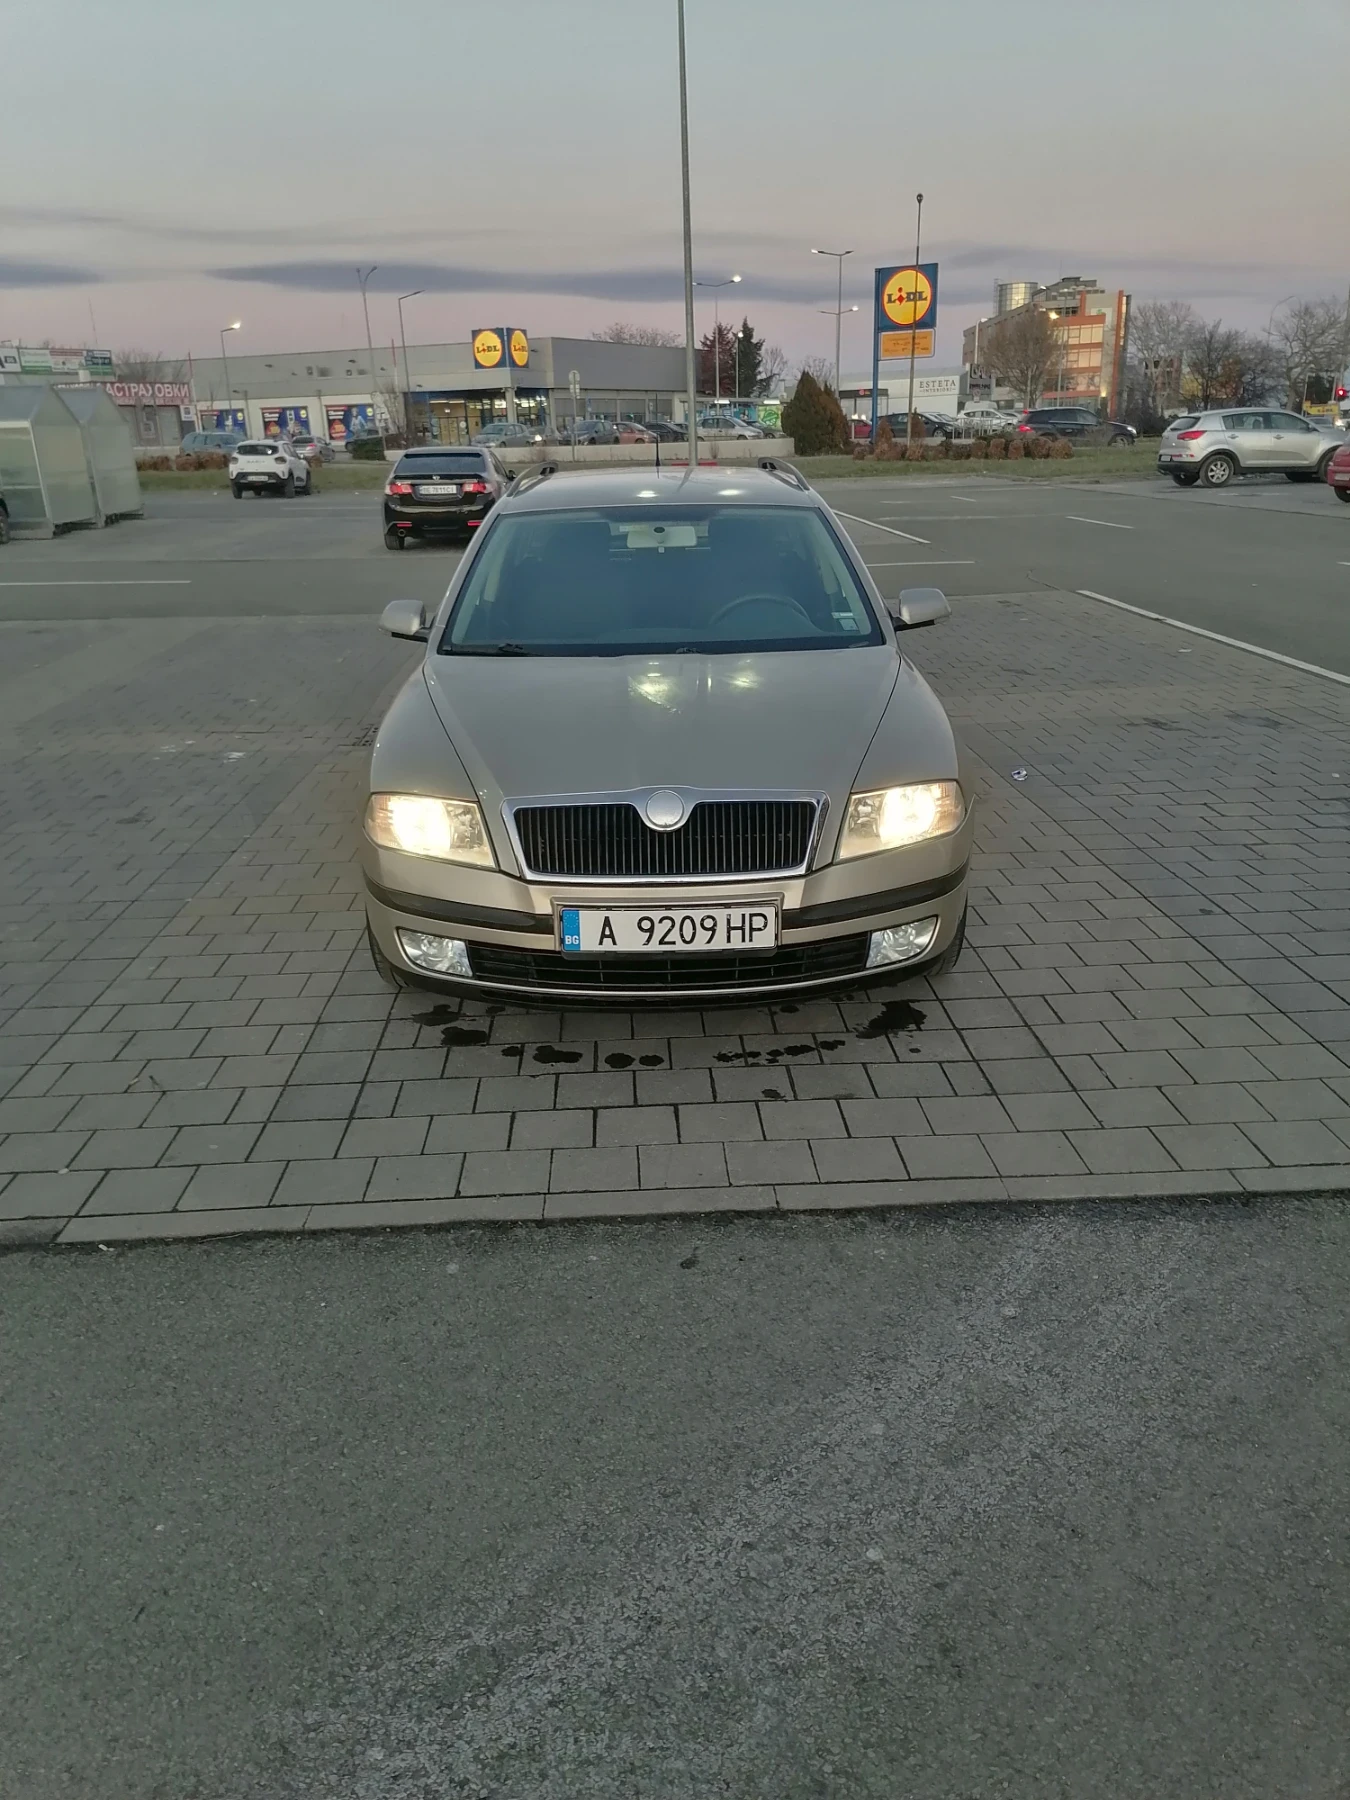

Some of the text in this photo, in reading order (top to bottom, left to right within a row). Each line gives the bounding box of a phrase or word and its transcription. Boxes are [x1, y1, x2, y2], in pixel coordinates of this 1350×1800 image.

[97, 382, 189, 397] АСТРАХОВКИ
[919, 379, 957, 389] ESTETA
[598, 912, 769, 946] A 9209 HP
[565, 935, 580, 945] BG
